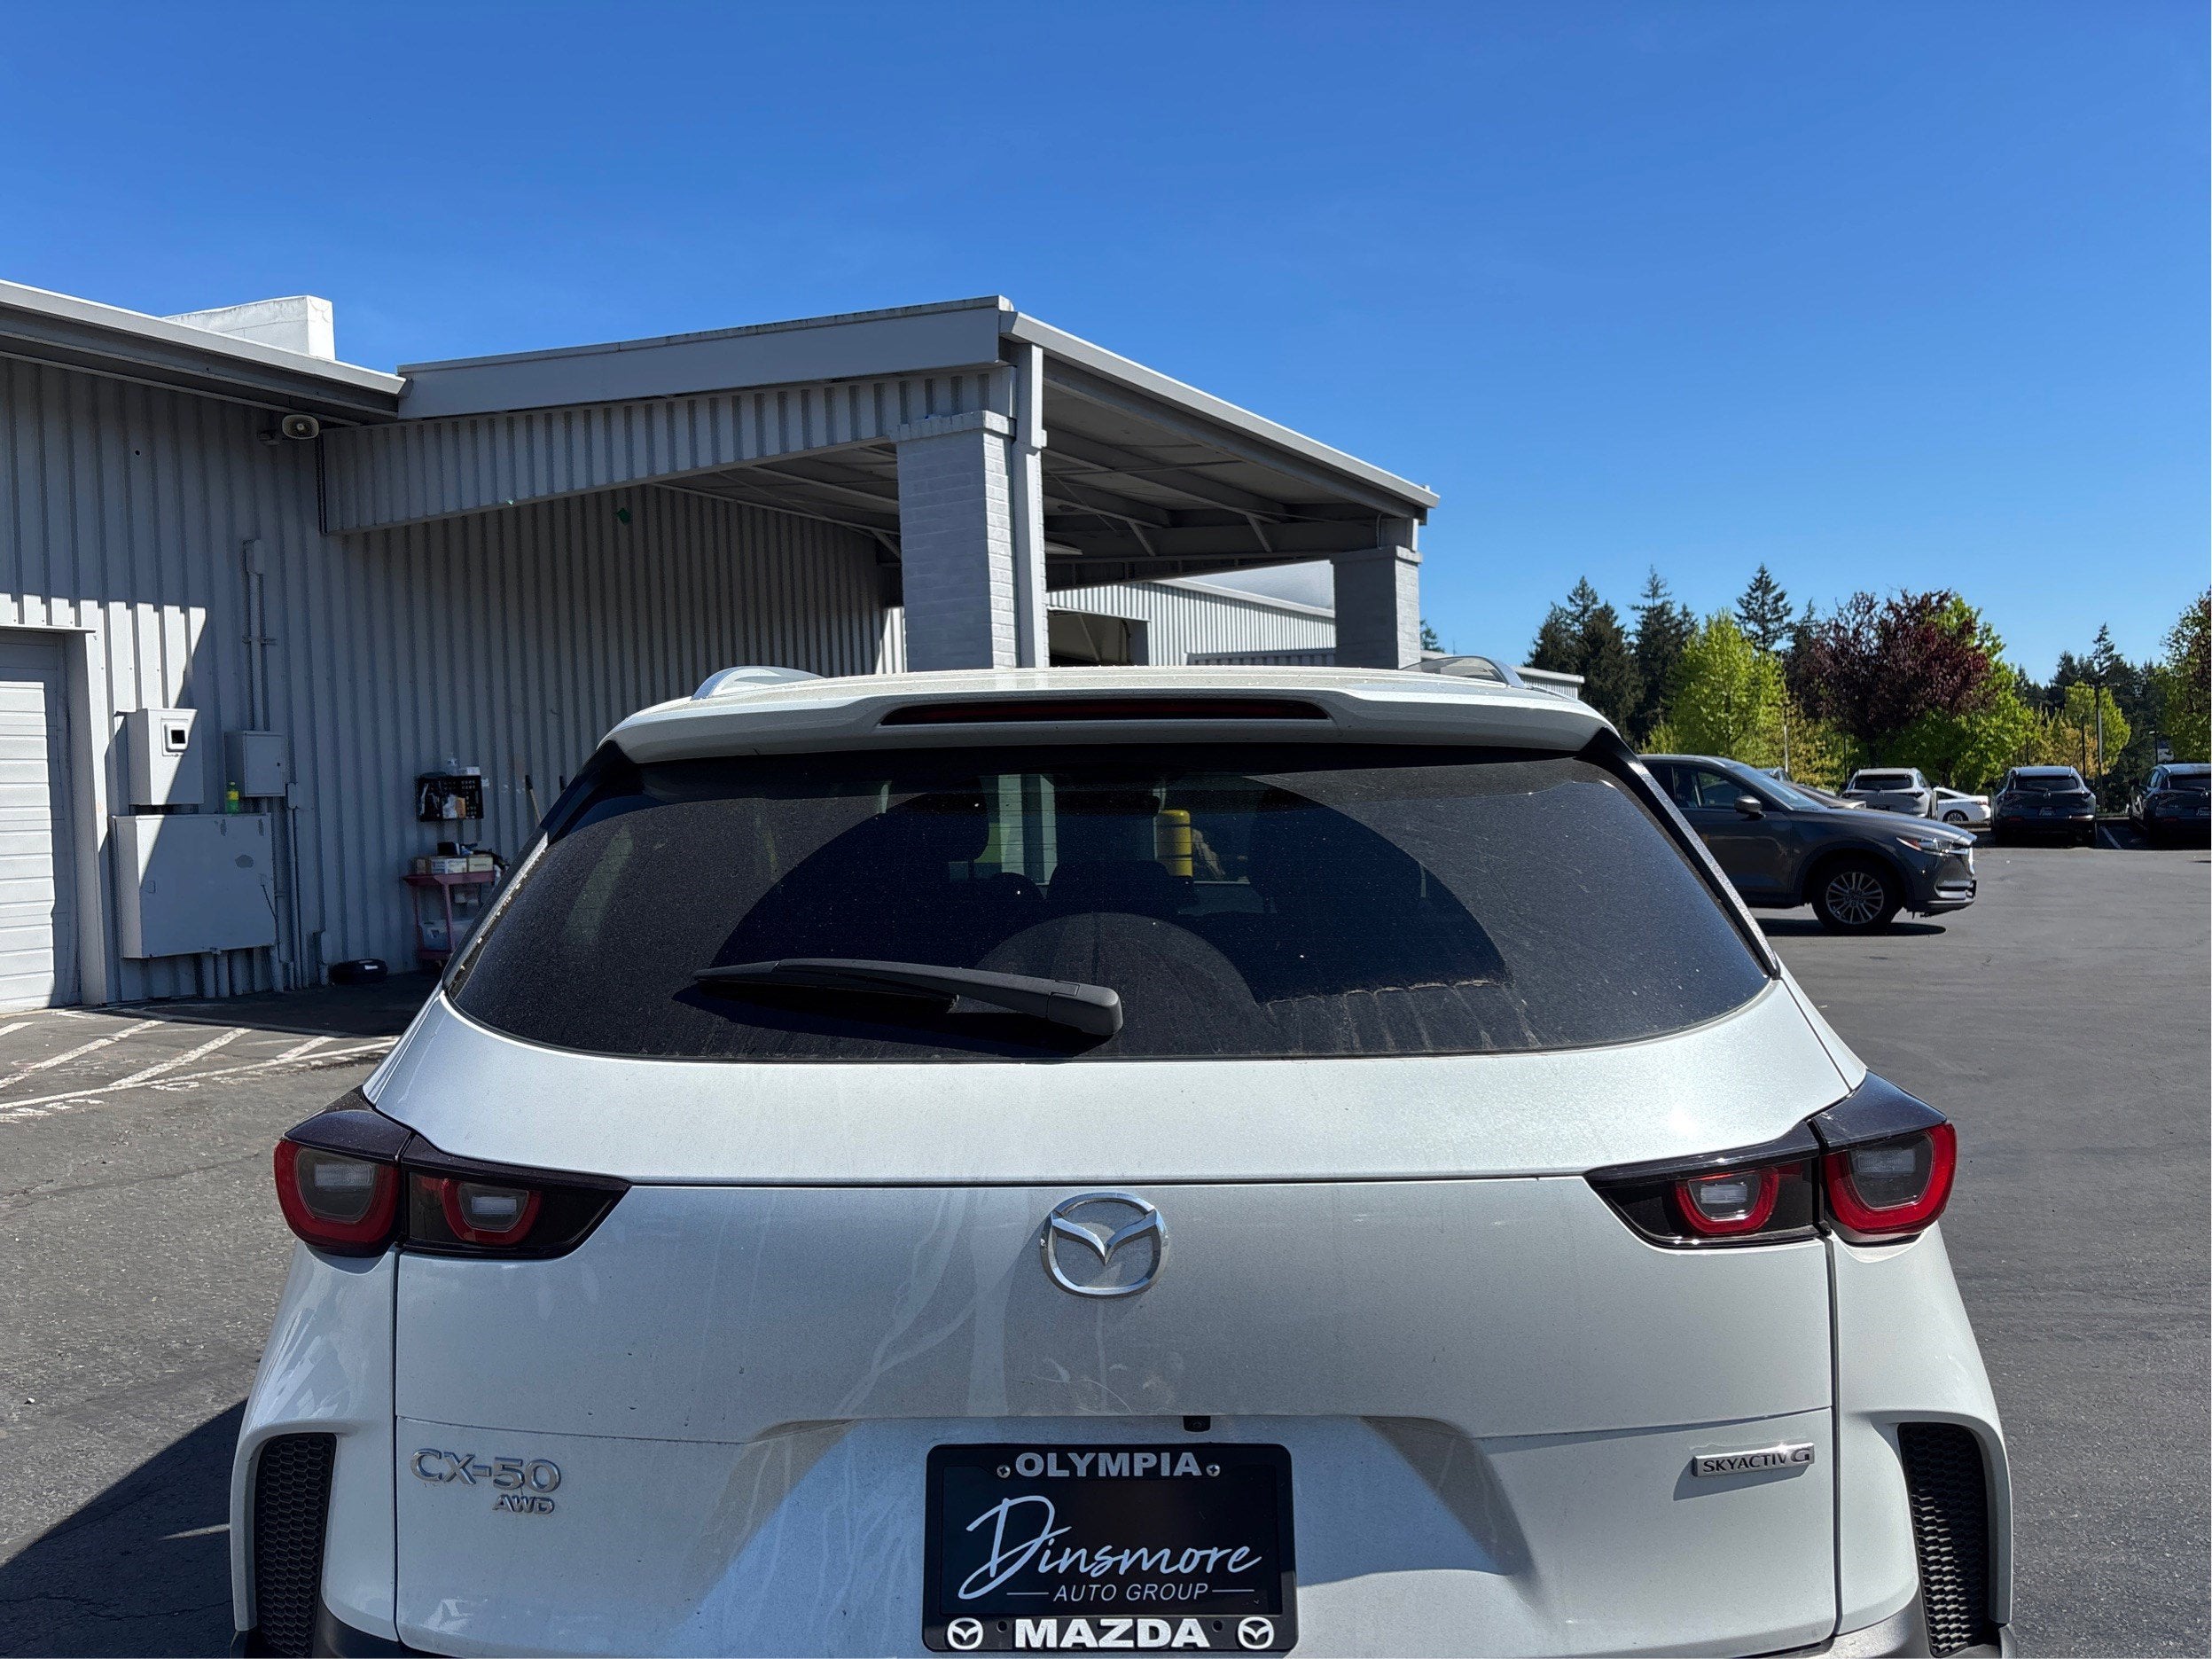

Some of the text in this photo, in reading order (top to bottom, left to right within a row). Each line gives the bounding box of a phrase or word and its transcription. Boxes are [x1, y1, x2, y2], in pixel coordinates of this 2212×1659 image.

[410, 1448, 561, 1493] CX-50
[1015, 1452, 1202, 1477] OLYMPIA
[1703, 1448, 1810, 1472] SKYACTIV G
[492, 1494, 555, 1514] AWD
[958, 1495, 1262, 1600] Dinsmore
[1053, 1583, 1208, 1602] AUTO GROUP
[1014, 1617, 1210, 1649] MAZDA
